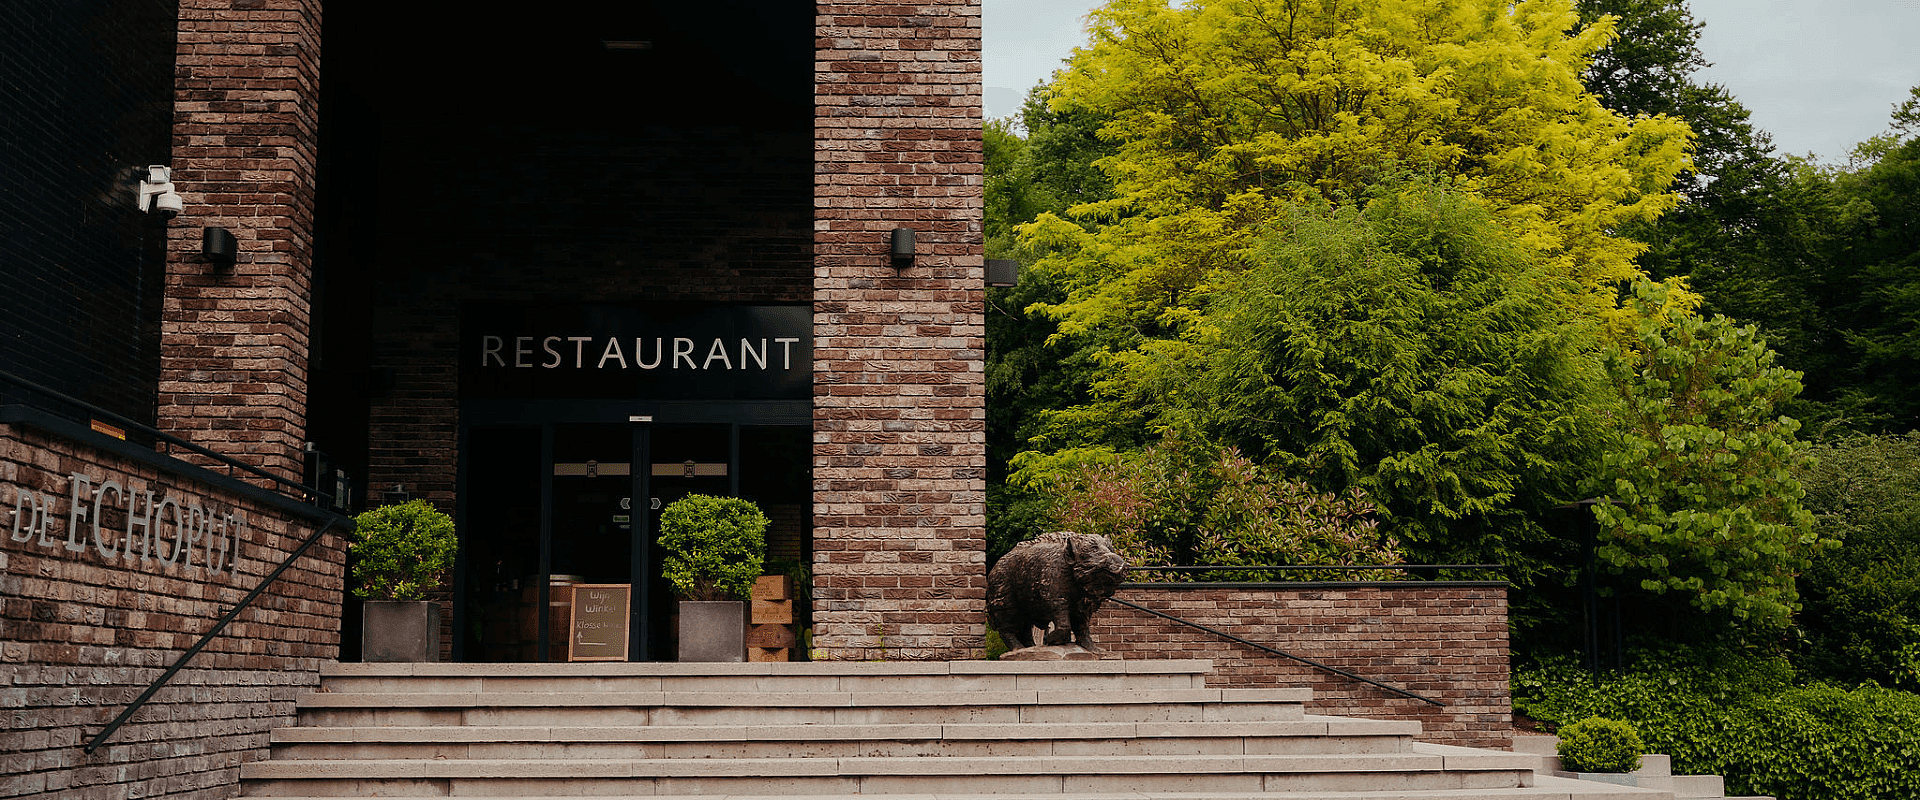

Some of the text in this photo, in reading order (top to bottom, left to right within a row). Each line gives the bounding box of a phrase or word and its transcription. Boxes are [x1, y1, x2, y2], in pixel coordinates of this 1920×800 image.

[482, 335, 800, 370] RESTAURANT
[11, 471, 248, 578] DE ECHOPUT
